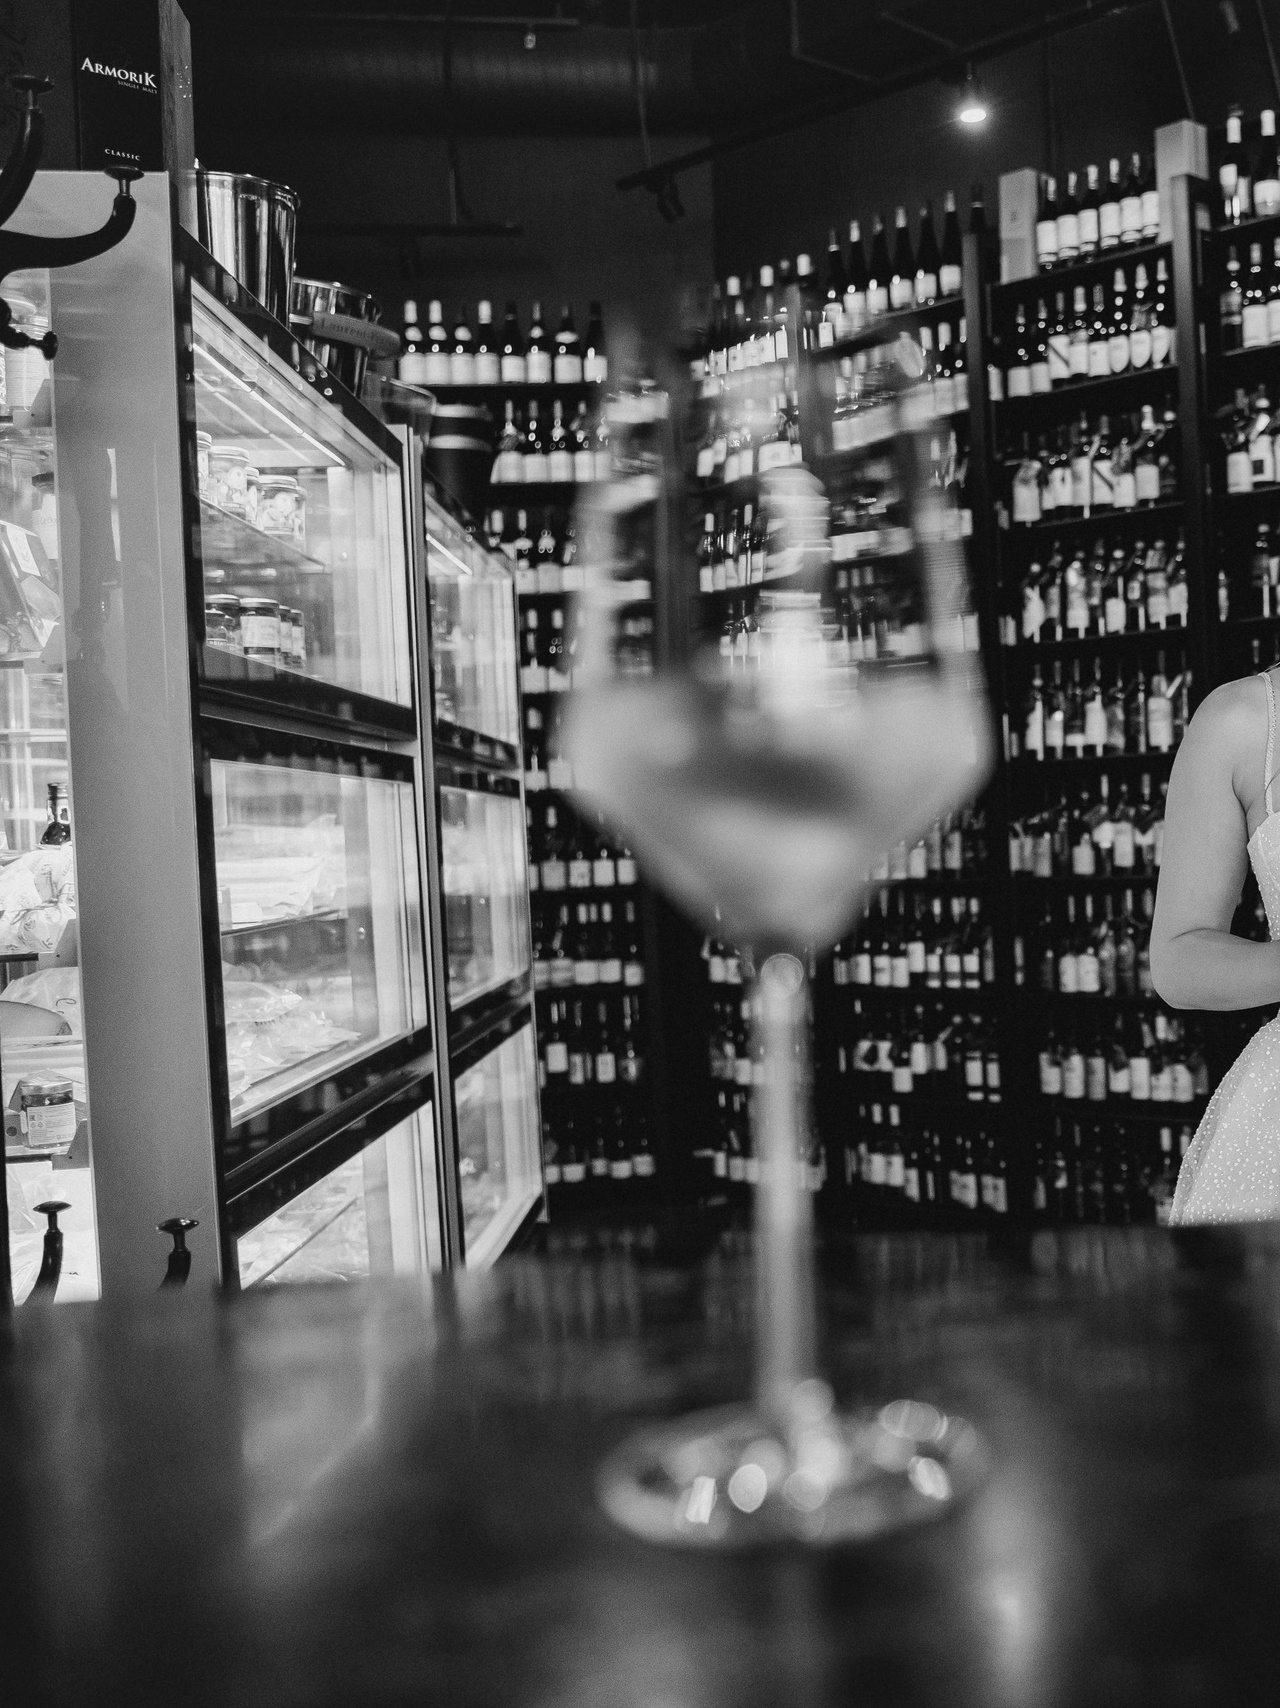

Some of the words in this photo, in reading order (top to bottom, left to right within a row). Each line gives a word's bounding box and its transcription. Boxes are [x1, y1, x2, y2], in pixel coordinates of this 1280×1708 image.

[117, 80, 140, 90] SINGLE
[142, 86, 158, 94] MALT
[104, 148, 141, 161] CLASSIC
